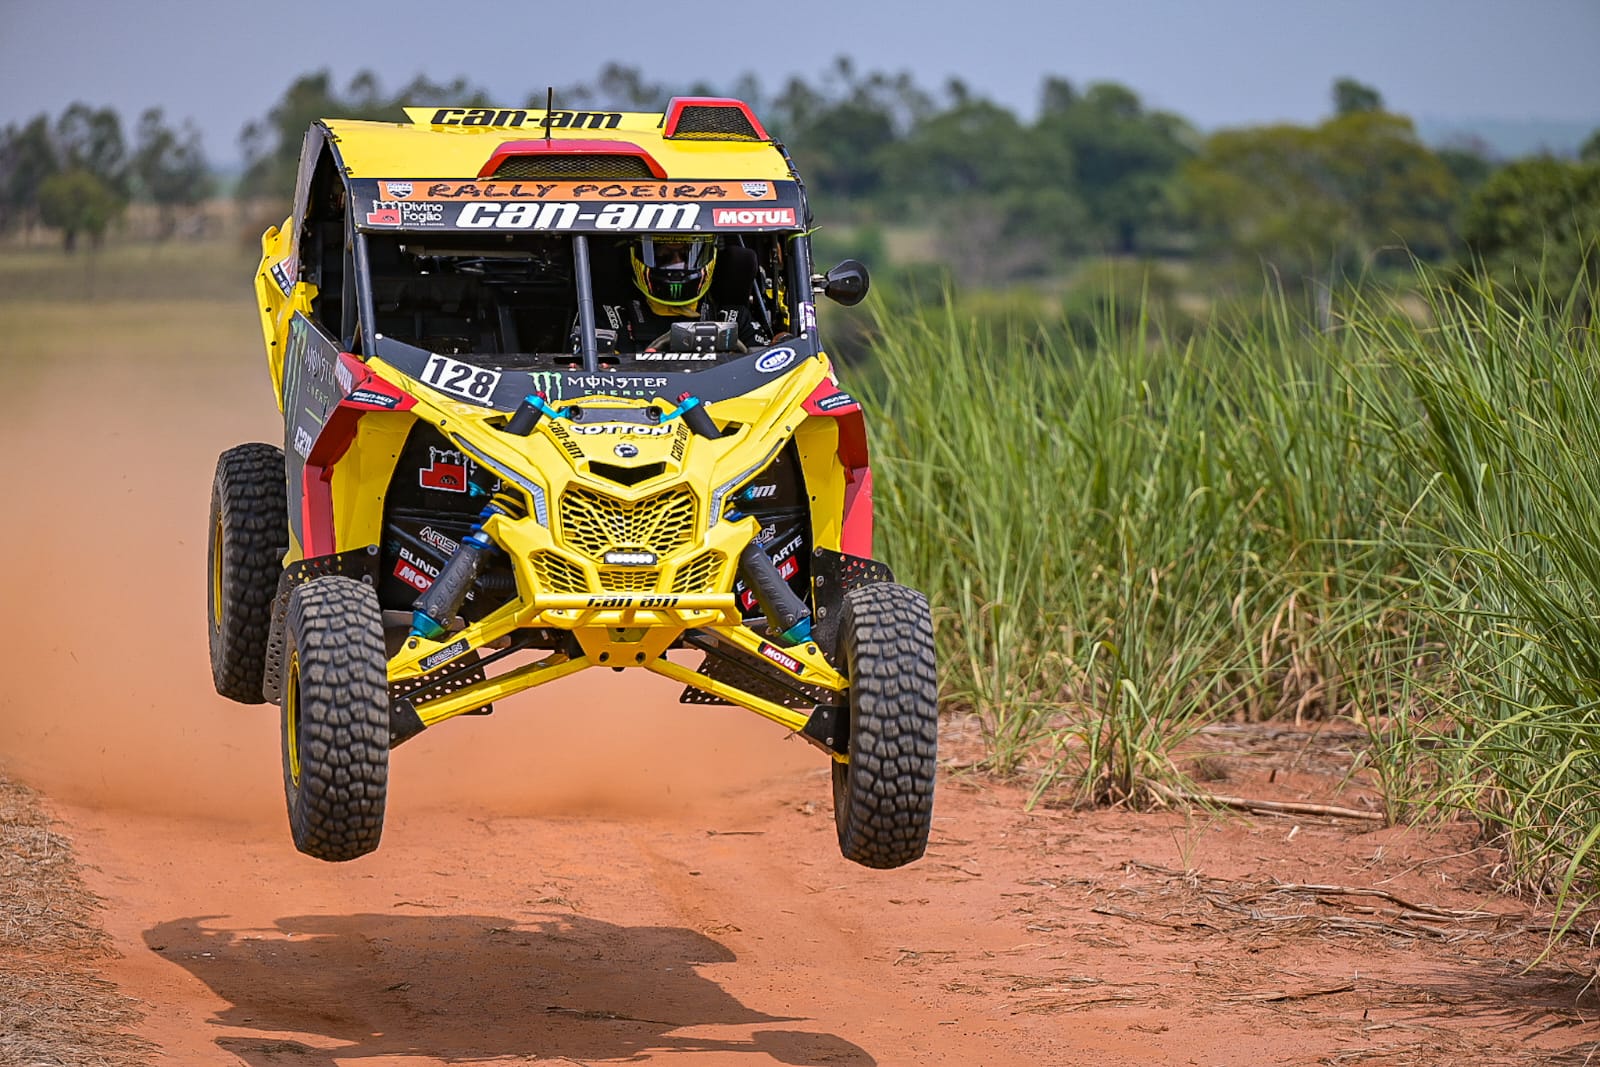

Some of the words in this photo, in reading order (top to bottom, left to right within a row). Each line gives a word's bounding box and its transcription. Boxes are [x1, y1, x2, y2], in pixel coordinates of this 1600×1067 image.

[430, 108, 622, 129] can-am
[427, 183, 558, 198] RALLY
[573, 184, 728, 198] POEIRA
[403, 202, 443, 211] Divino
[403, 212, 442, 223] Fogão
[456, 202, 698, 230] can-am
[717, 211, 792, 225] MOTUL
[635, 353, 717, 361] VARELA
[429, 357, 495, 399] 128
[567, 375, 668, 389] MONSTER
[570, 424, 672, 436] COTTON
[547, 420, 585, 459] can-am
[670, 422, 690, 462] can-am
[764, 646, 797, 671] MOTUL
